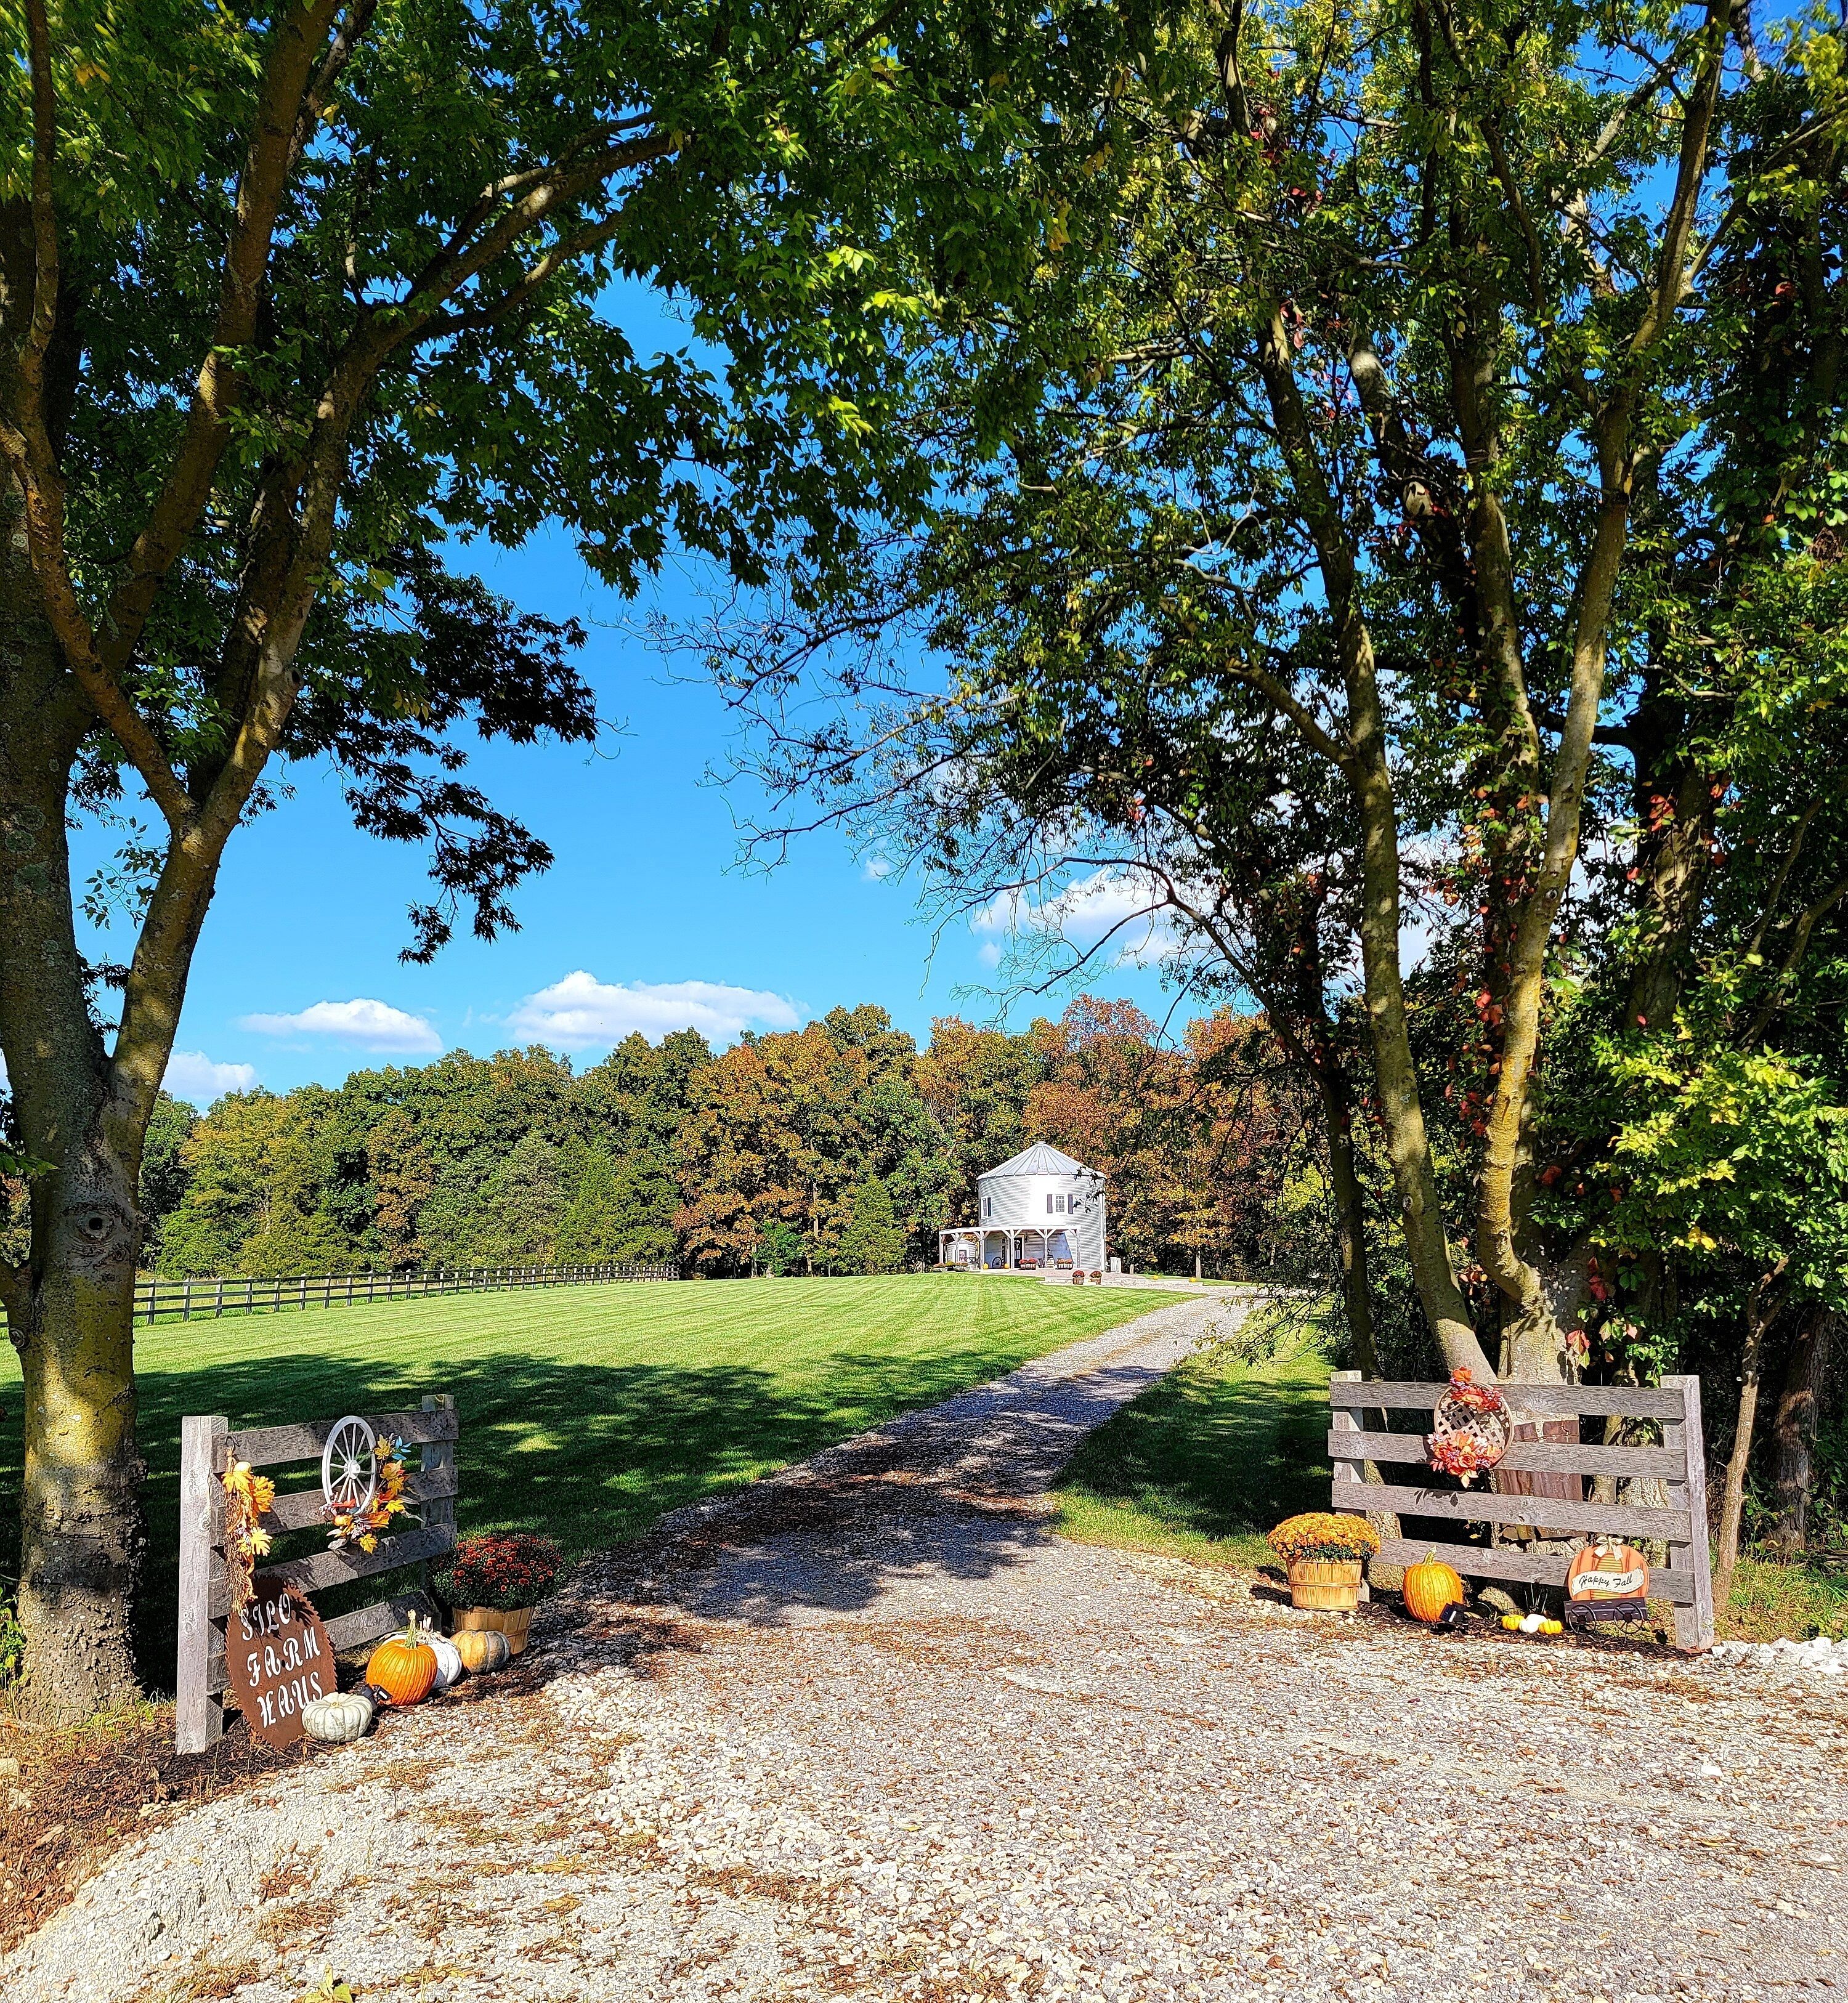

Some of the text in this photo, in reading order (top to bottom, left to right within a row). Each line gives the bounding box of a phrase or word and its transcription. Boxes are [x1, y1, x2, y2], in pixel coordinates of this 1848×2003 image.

[1578, 1574, 1633, 1588] Happy Fall
[240, 1593, 291, 1641] SILO
[247, 1627, 321, 1687] FARM
[256, 1671, 323, 1728] HAUS
